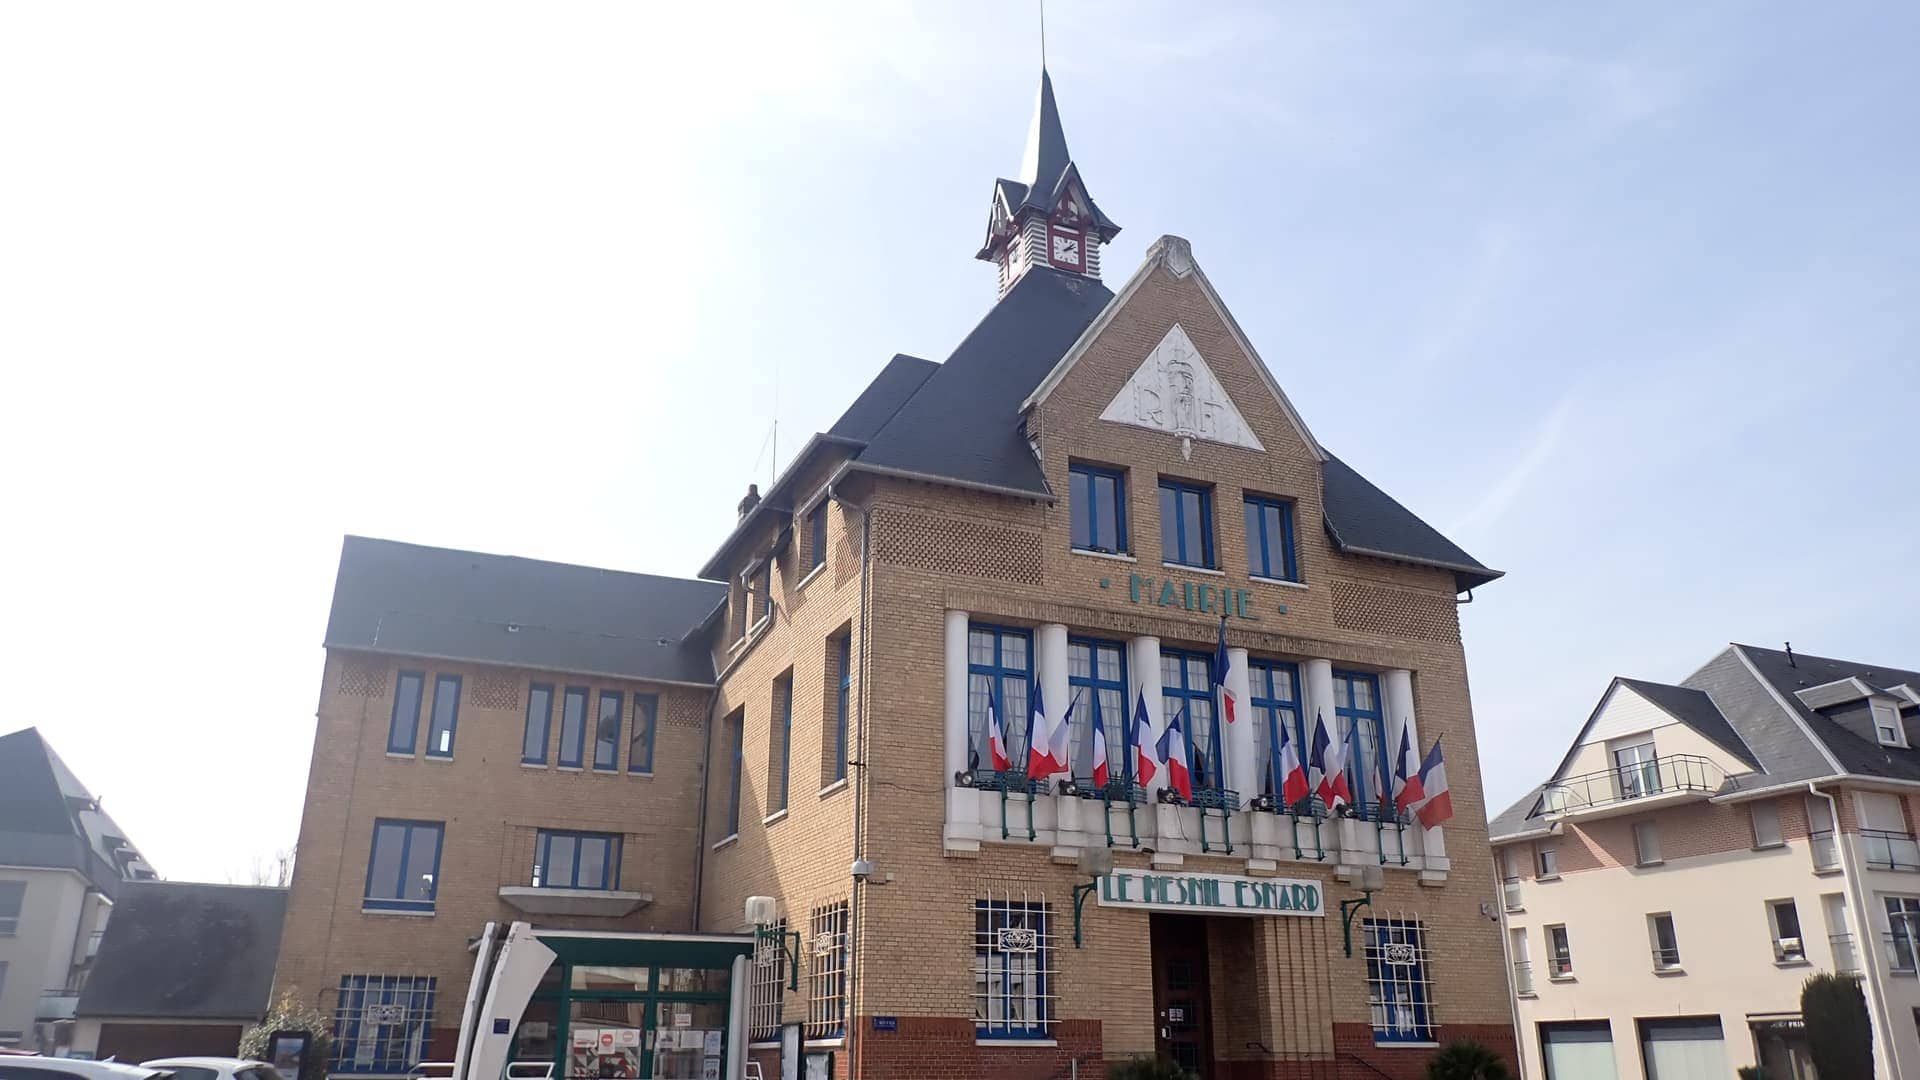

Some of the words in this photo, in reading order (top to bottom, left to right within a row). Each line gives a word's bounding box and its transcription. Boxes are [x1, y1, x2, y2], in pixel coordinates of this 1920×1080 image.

[1129, 571, 1259, 619] MAIRIE
[1102, 872, 1133, 902] LE
[1143, 874, 1226, 907] MESNIL
[1234, 880, 1320, 912] ESNARD
